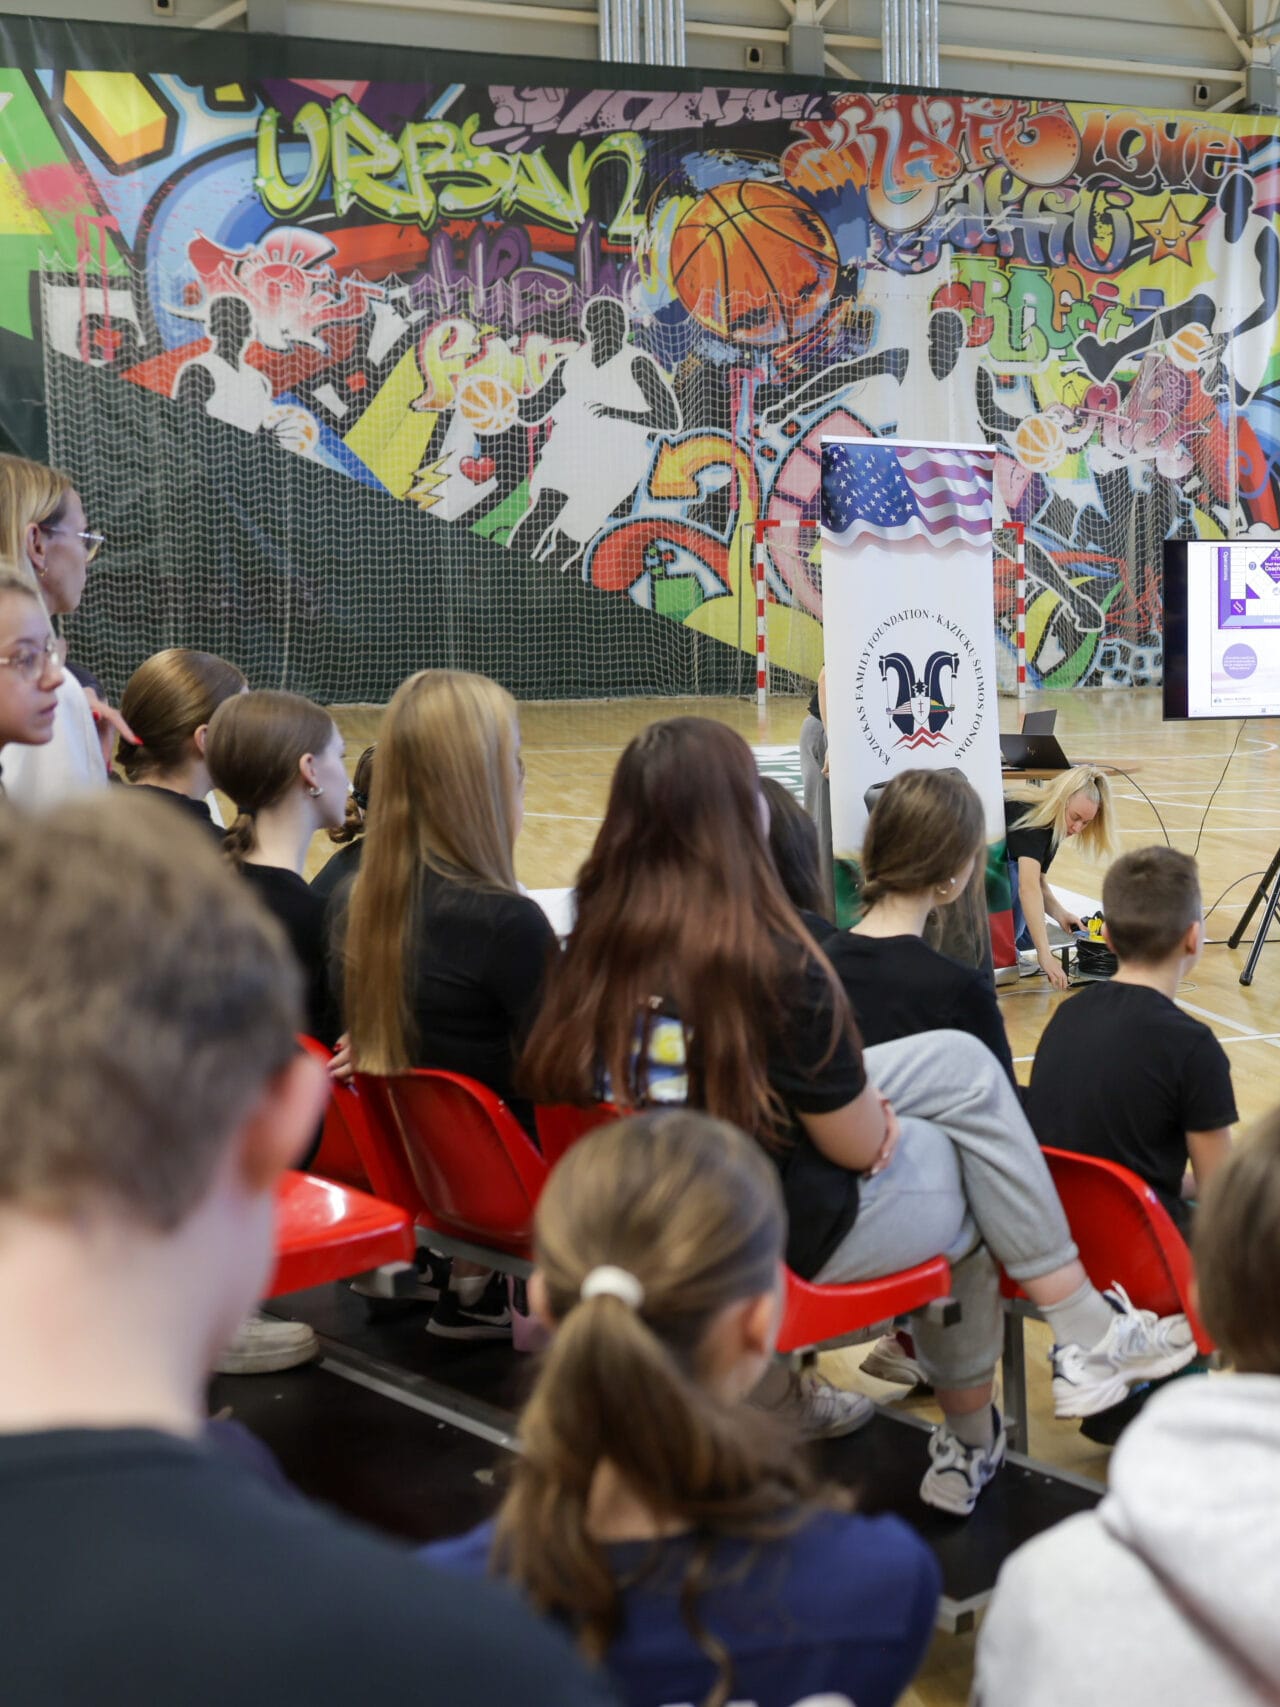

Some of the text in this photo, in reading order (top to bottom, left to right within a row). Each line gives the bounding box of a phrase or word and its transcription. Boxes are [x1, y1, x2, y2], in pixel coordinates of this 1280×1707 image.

[855, 608, 929, 765] KAZICKAS FAMILY FOUNDATION
[972, 659, 985, 710] ŠEIMOS
[954, 714, 983, 760] FONDAS
